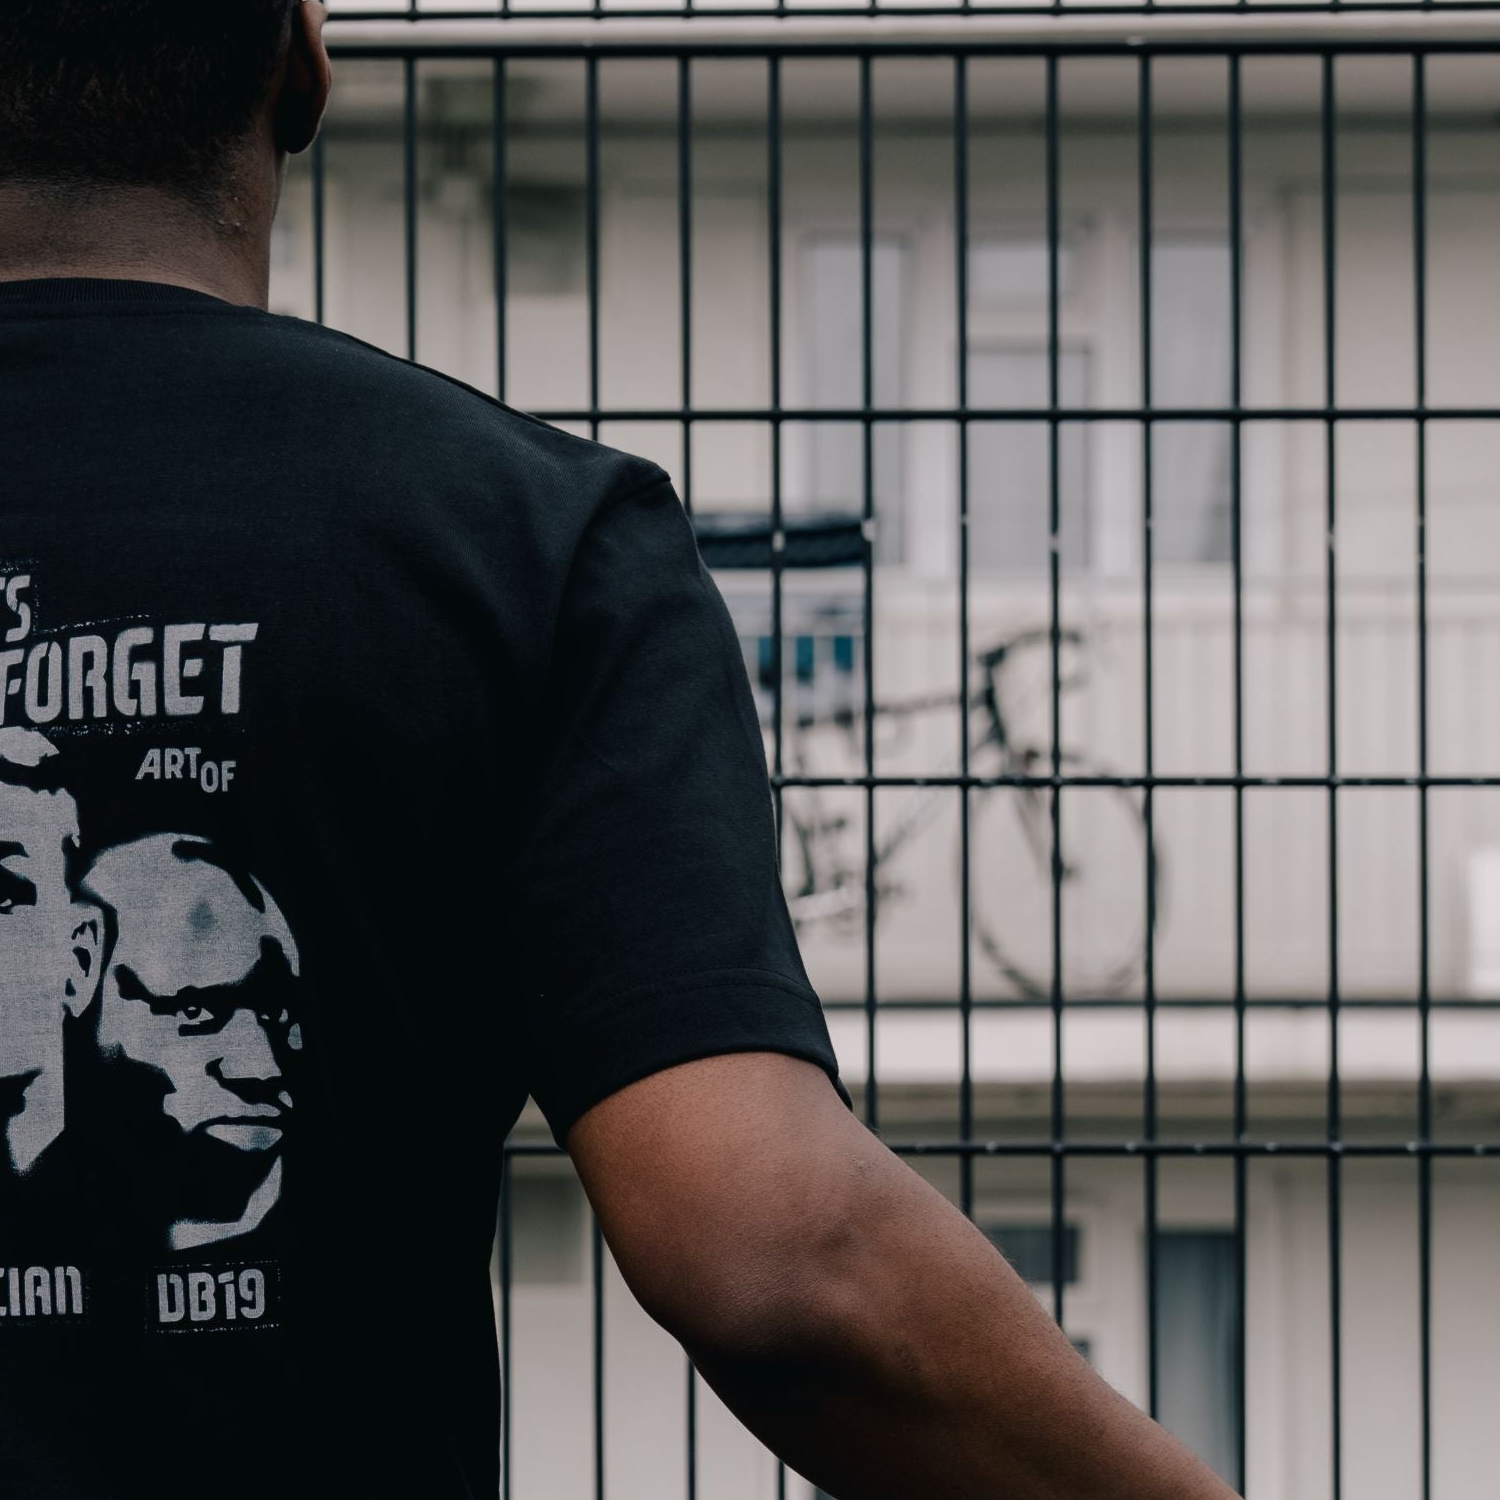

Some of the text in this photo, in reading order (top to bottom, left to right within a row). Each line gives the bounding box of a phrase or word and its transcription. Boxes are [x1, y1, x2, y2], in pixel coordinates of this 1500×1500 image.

[134, 747, 238, 794] ART OF
[157, 1268, 267, 1323] DB19
